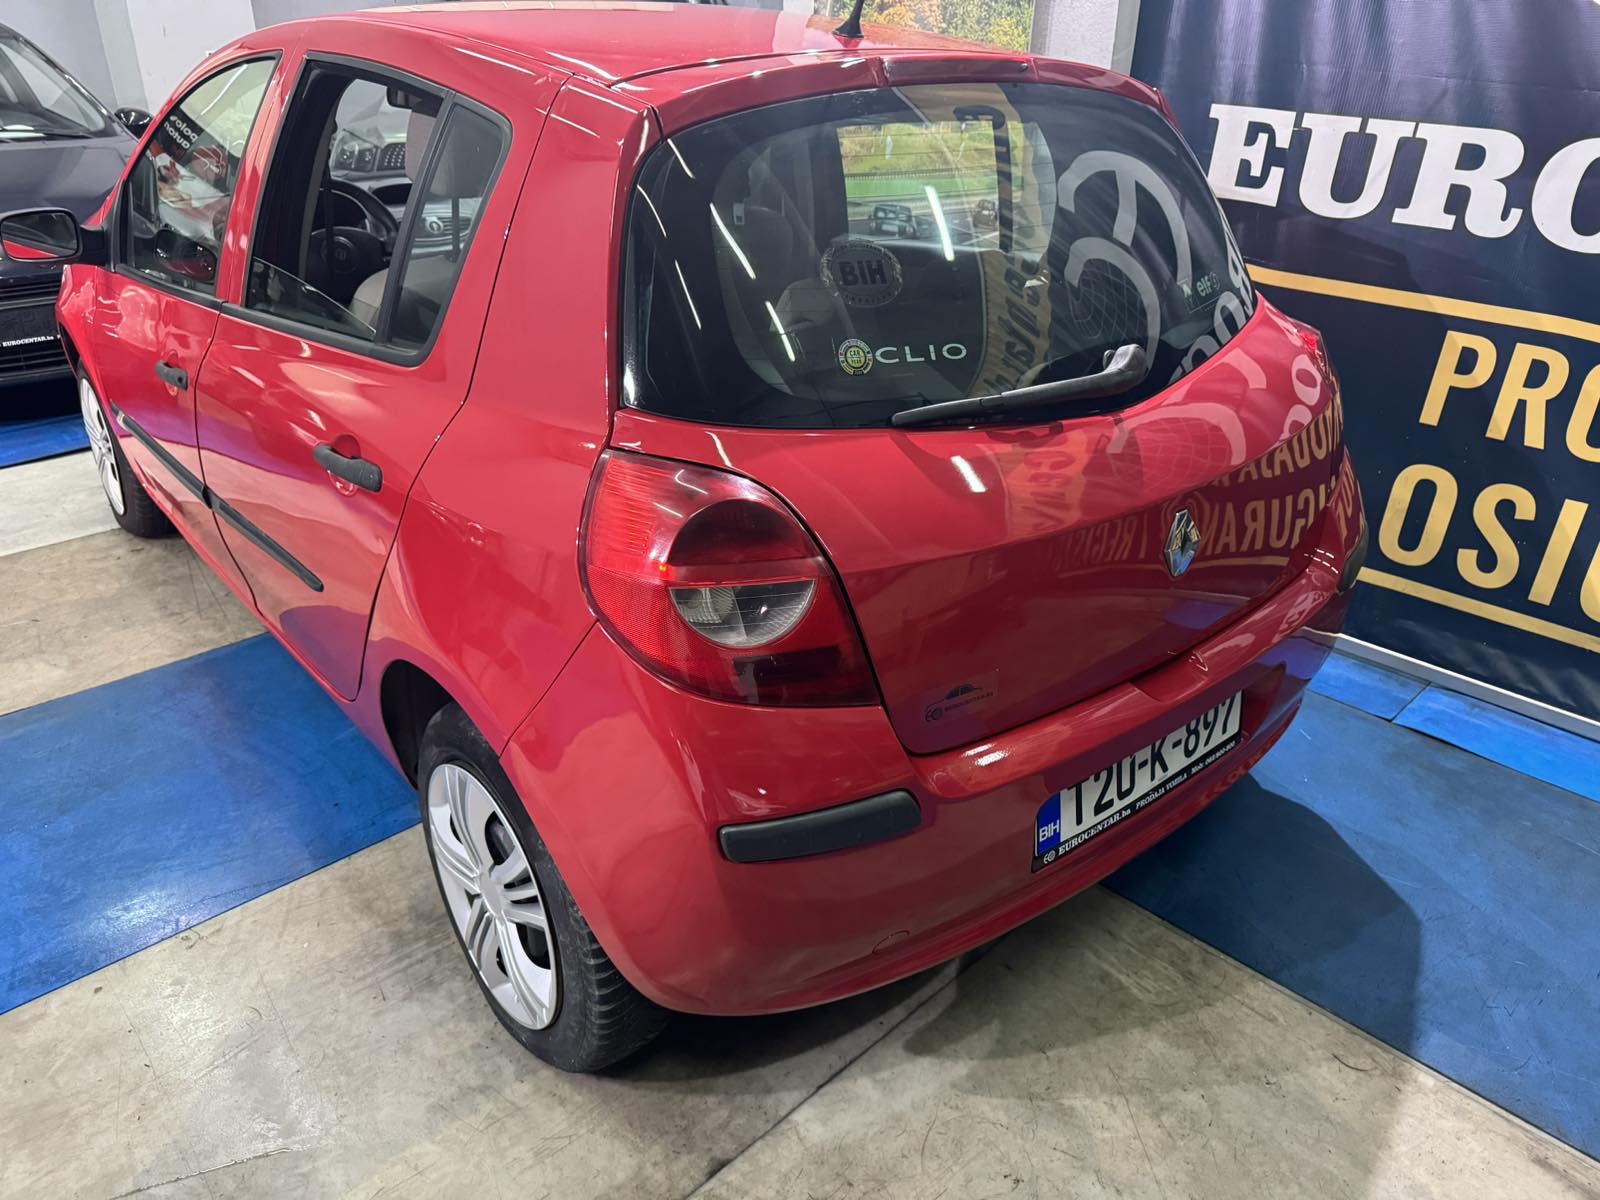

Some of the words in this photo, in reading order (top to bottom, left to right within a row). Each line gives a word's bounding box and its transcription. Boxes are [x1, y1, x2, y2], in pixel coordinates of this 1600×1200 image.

[1209, 103, 1600, 255] EURO
[838, 259, 888, 286] BIH
[875, 343, 968, 364] CLIO
[1378, 463, 1600, 627] OSI
[1040, 819, 1060, 842] BIH
[1059, 808, 1131, 856] EUROCENTAR.ba
